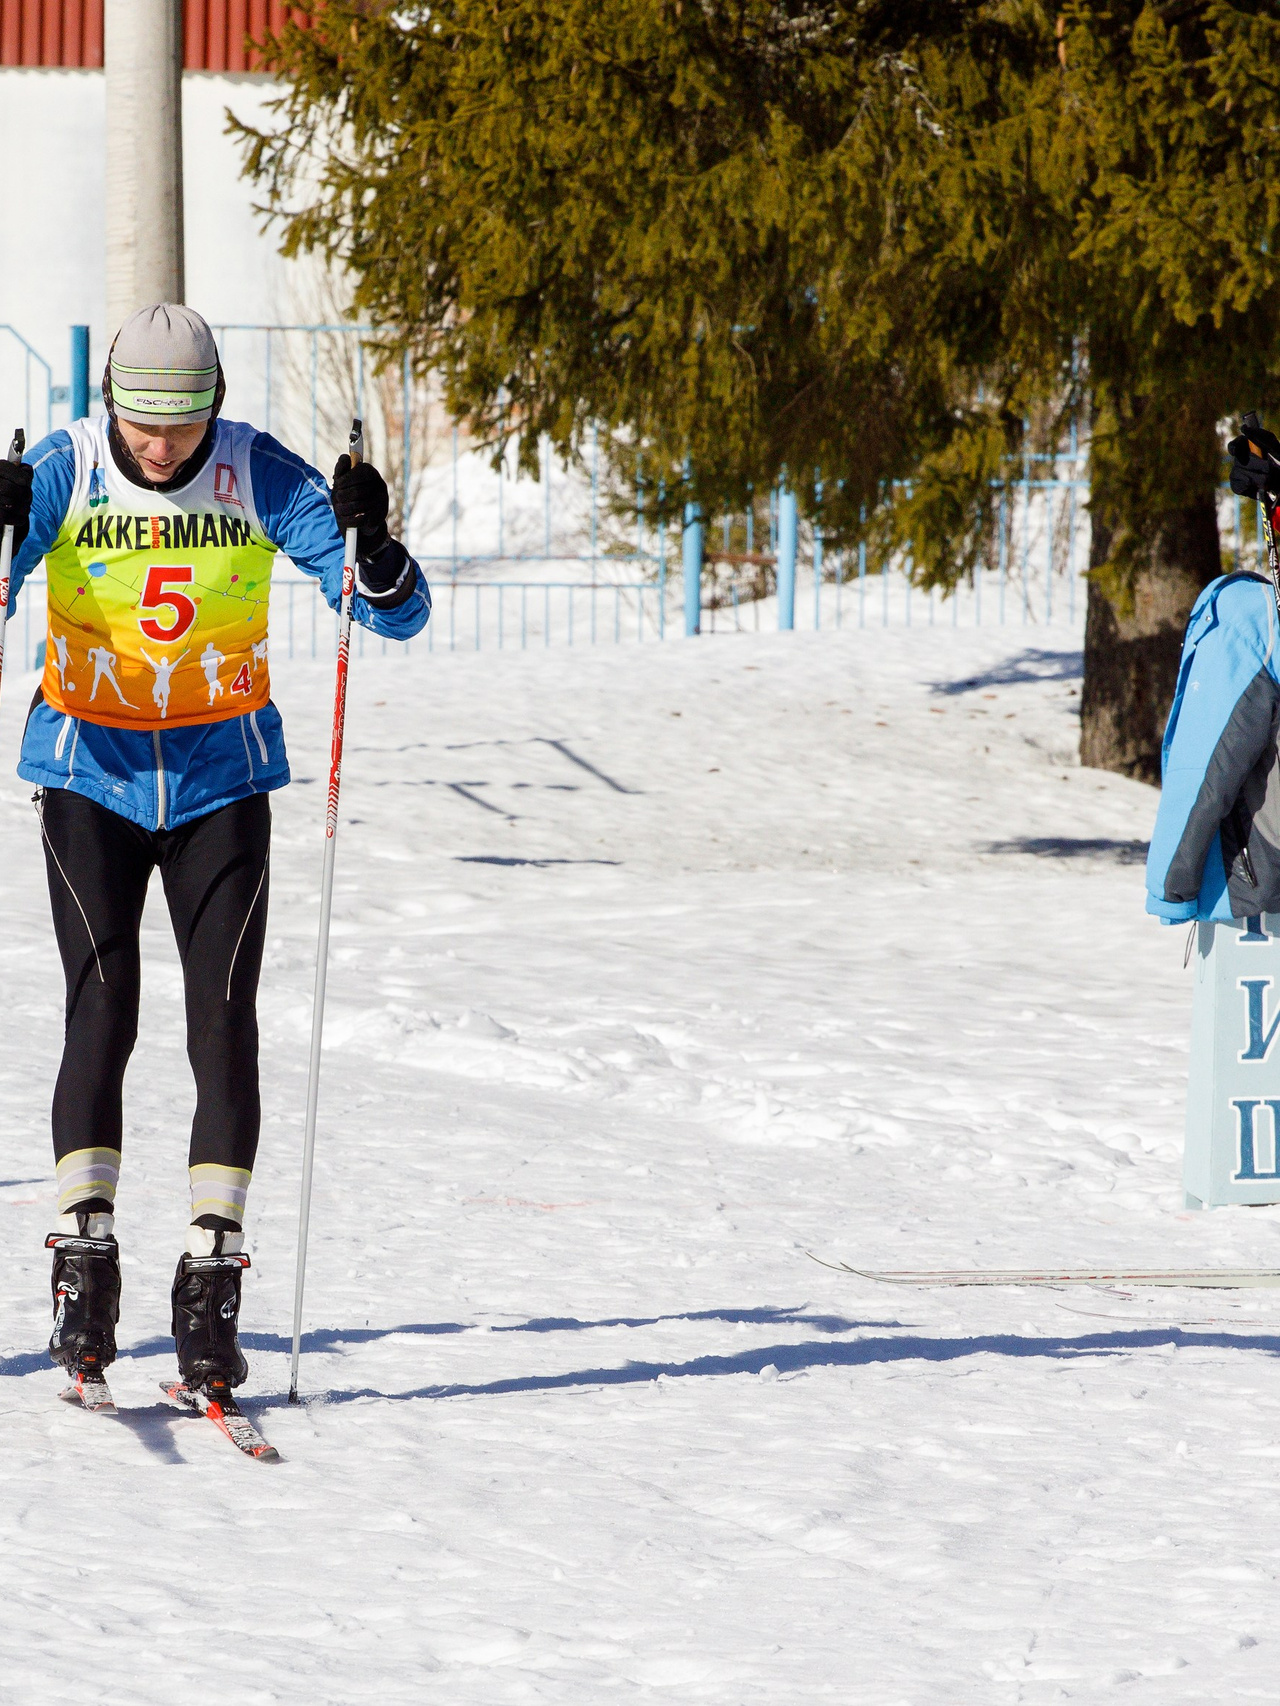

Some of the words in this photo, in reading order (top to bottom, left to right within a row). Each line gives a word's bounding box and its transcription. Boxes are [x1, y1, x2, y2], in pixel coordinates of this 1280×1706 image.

[75, 513, 257, 549] AKKERMANN
[150, 516, 160, 549] cement
[137, 564, 197, 644] 5
[230, 661, 253, 696] 4
